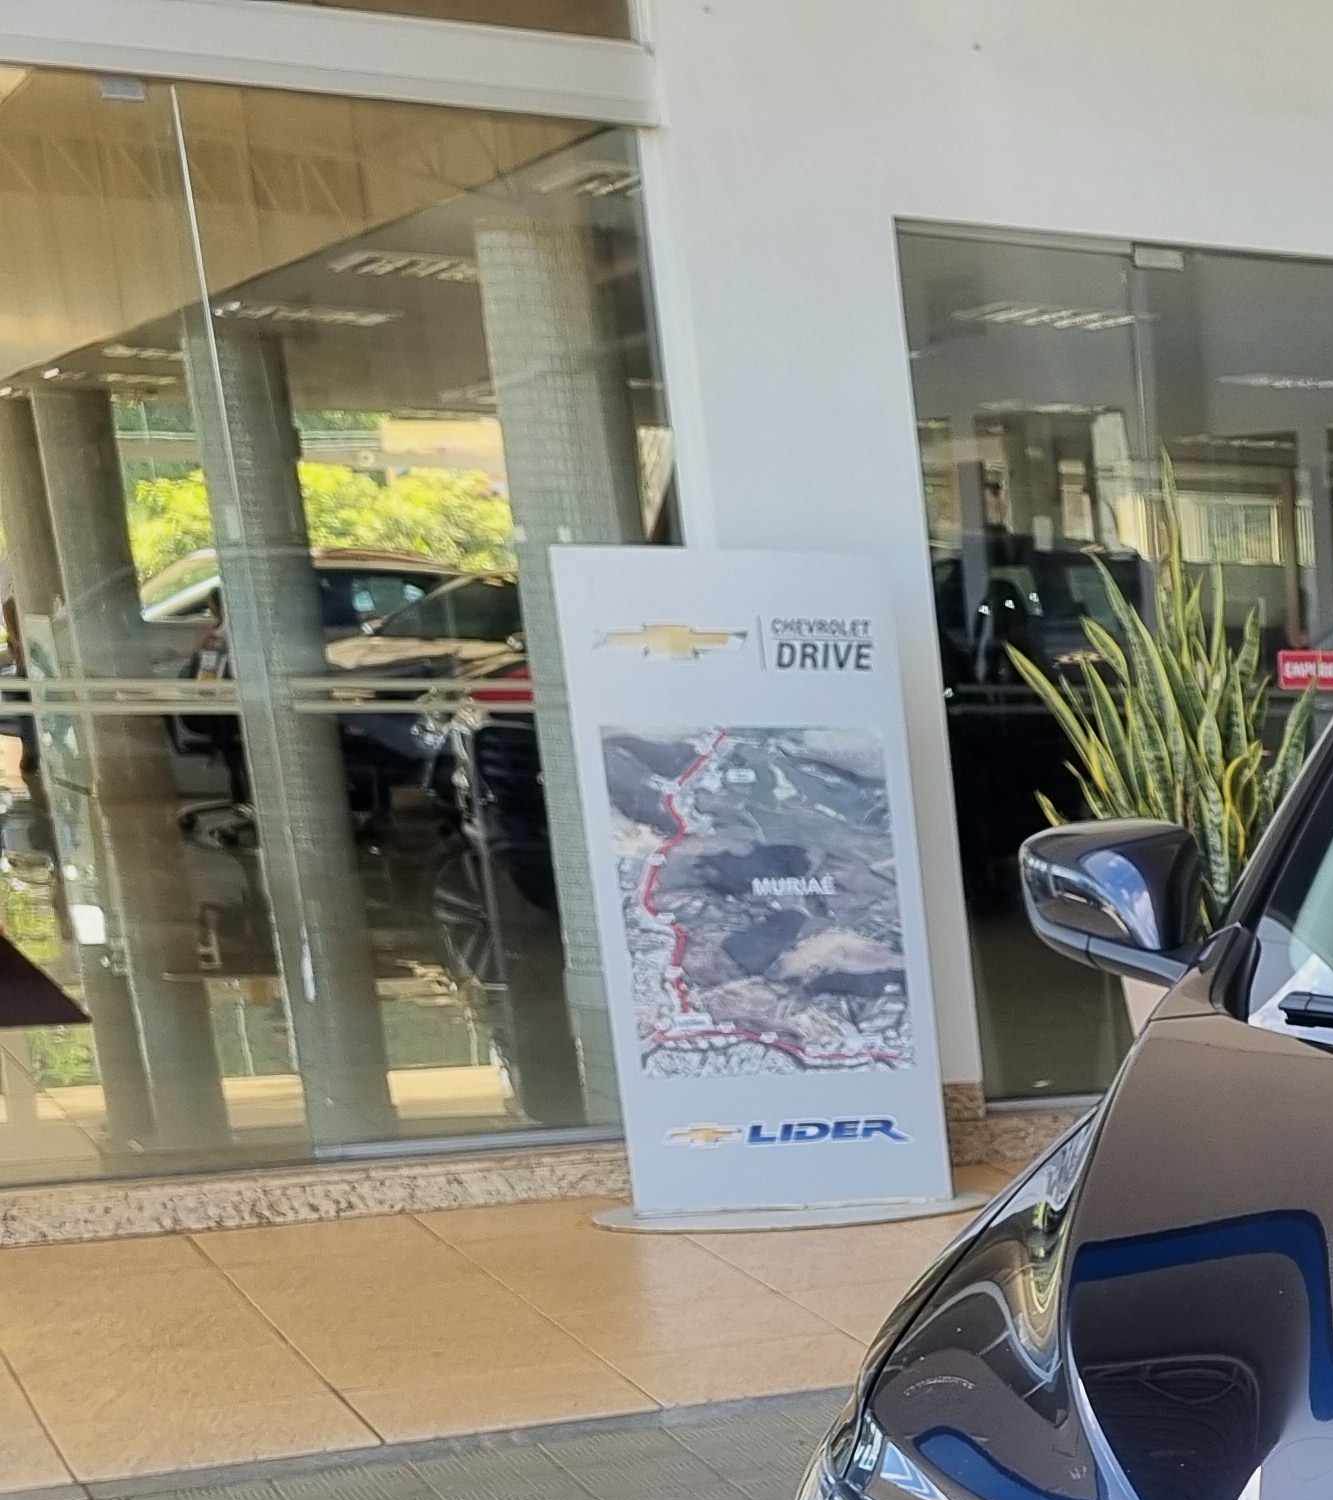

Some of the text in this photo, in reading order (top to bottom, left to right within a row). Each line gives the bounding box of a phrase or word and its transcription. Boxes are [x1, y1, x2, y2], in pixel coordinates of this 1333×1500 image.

[771, 617, 872, 637] CHEVROLET
[776, 642, 874, 671] DRIVE
[751, 872, 837, 896] MURIAÉ
[748, 1118, 912, 1144] LIDER
